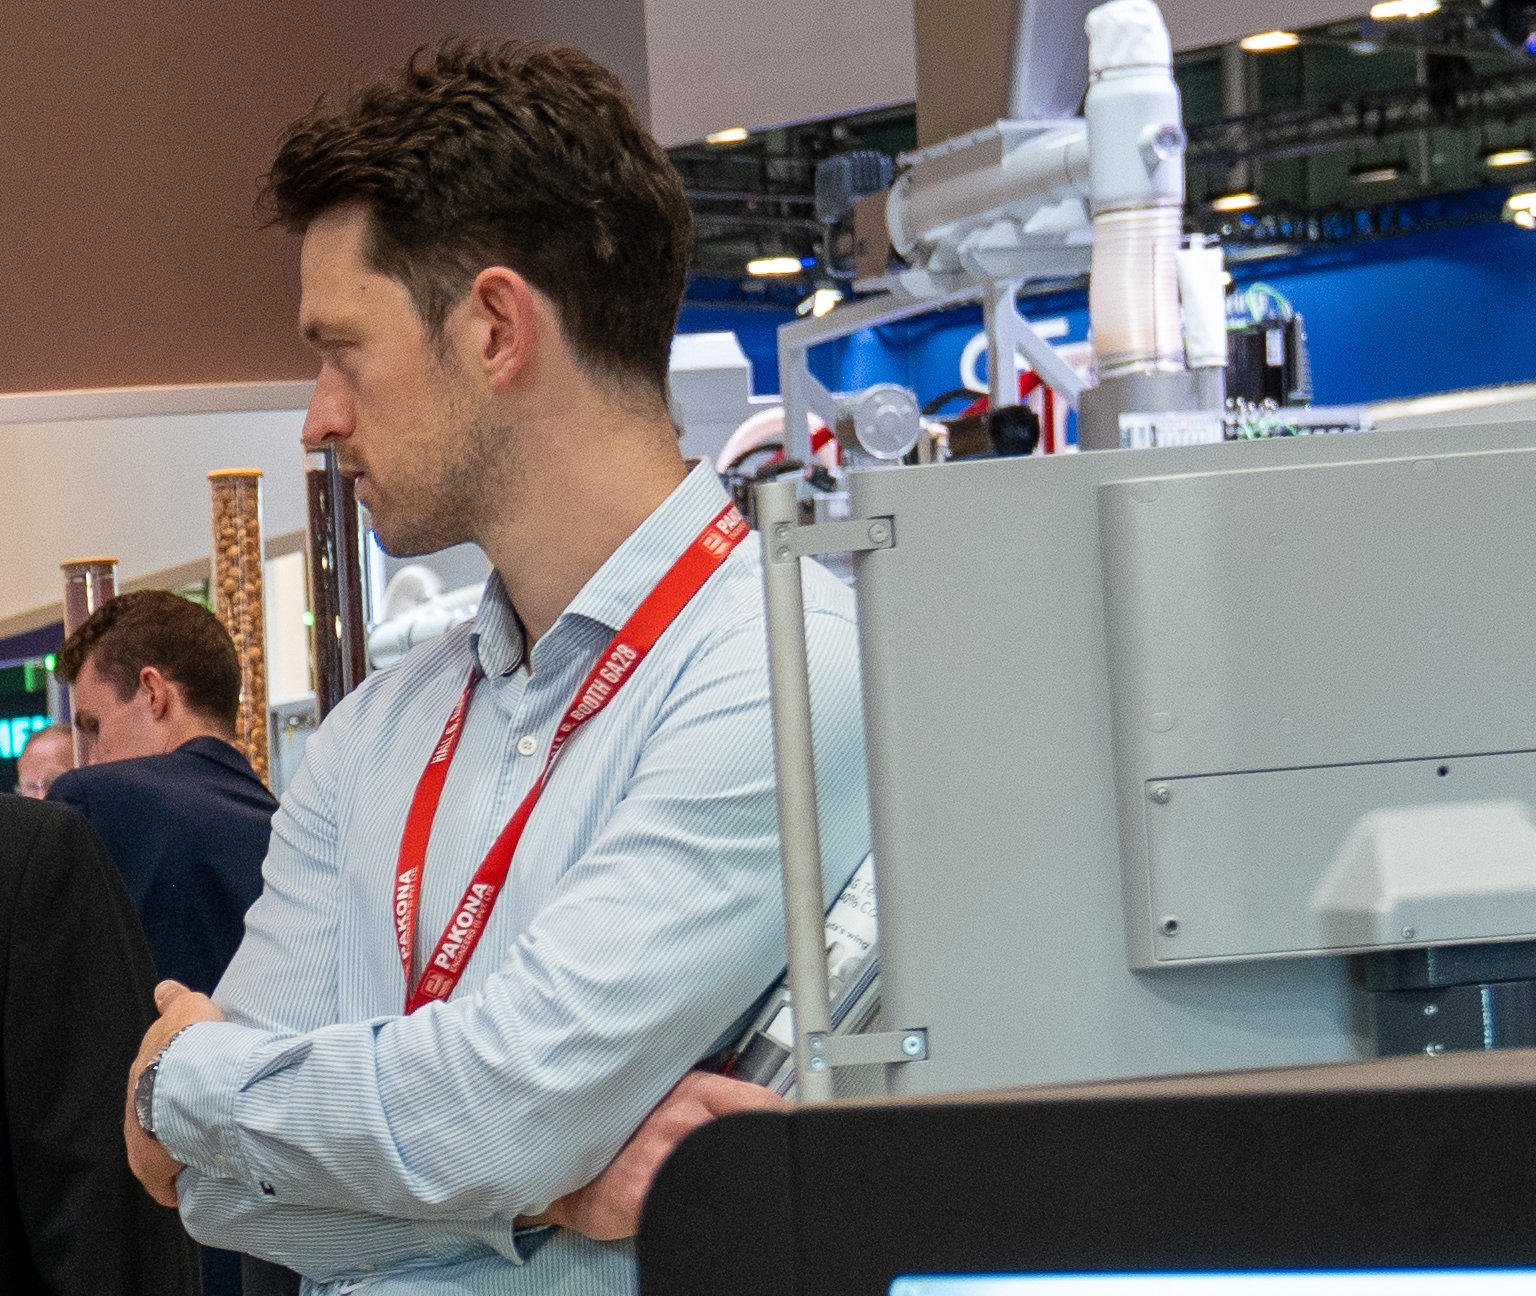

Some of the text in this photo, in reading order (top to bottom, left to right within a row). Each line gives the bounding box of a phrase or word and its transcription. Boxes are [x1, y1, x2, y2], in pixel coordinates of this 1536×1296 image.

[570, 679, 611, 720] BOOTH
[600, 644, 637, 684] 6A28
[396, 869, 412, 960] PAKONA
[434, 883, 488, 970] PAKONA
